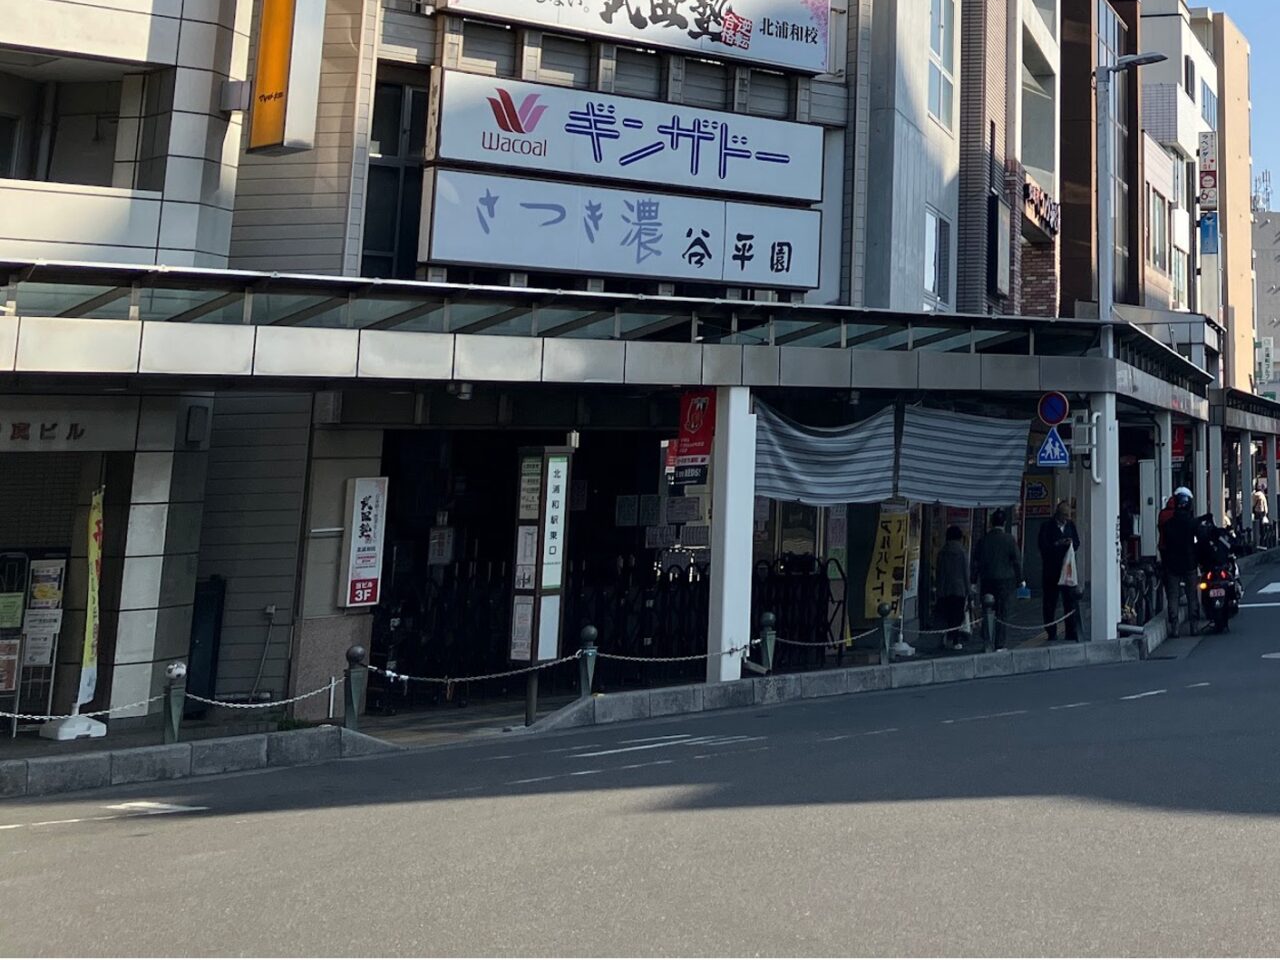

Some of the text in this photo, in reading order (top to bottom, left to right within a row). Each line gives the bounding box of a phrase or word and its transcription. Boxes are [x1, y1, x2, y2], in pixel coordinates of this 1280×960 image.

[759, 17, 819, 45] 北浦和校
[482, 130, 547, 157] Wacoal
[564, 101, 791, 180] ギンザドー
[681, 227, 793, 274] 谷平園
[549, 468, 562, 556] 北浦和駅東口
[354, 589, 372, 601] 3F
